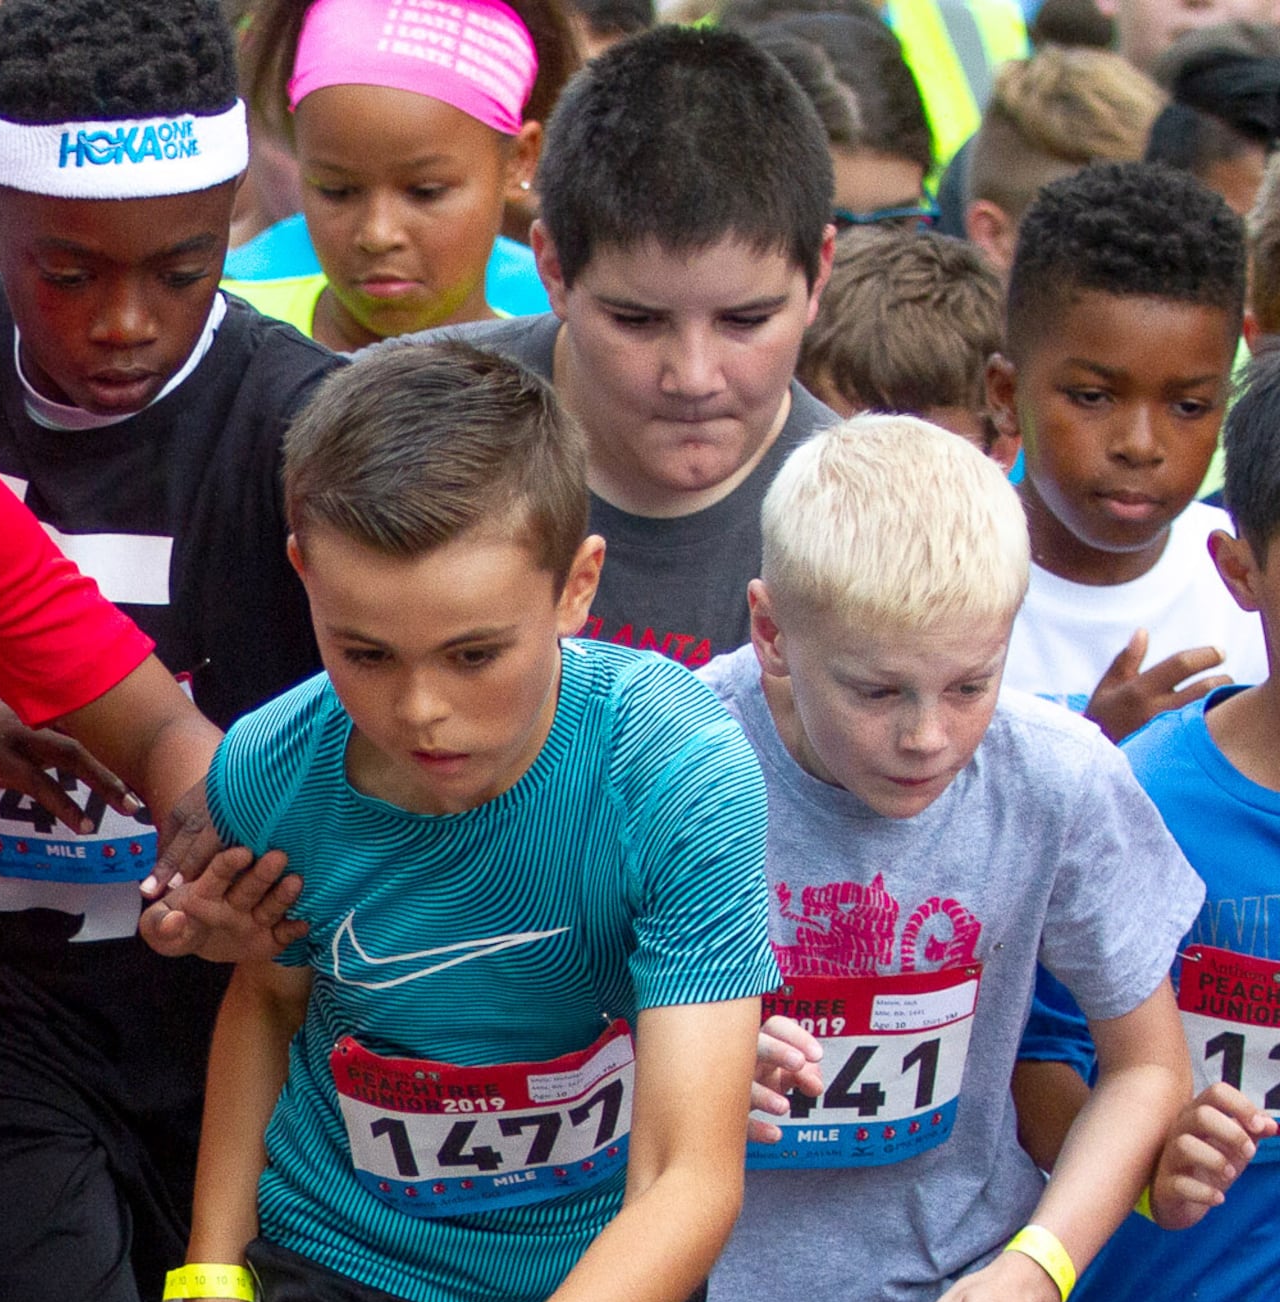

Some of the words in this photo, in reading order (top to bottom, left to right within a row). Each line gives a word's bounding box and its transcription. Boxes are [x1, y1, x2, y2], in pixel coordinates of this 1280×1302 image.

[158, 121, 195, 142] ONE
[58, 126, 163, 168] HOKA
[163, 139, 199, 159] ONE
[45, 844, 87, 859] MILE
[791, 1016, 846, 1037] 019
[348, 1066, 500, 1097] PEACHTREE
[354, 1085, 441, 1112] JUNIOR
[442, 1097, 506, 1113] 2019
[370, 1079, 623, 1177] 1477
[797, 1128, 840, 1143] MILE
[493, 1170, 537, 1188] MILE
[194, 1275, 206, 1285] 10
[216, 1275, 228, 1285] 10
